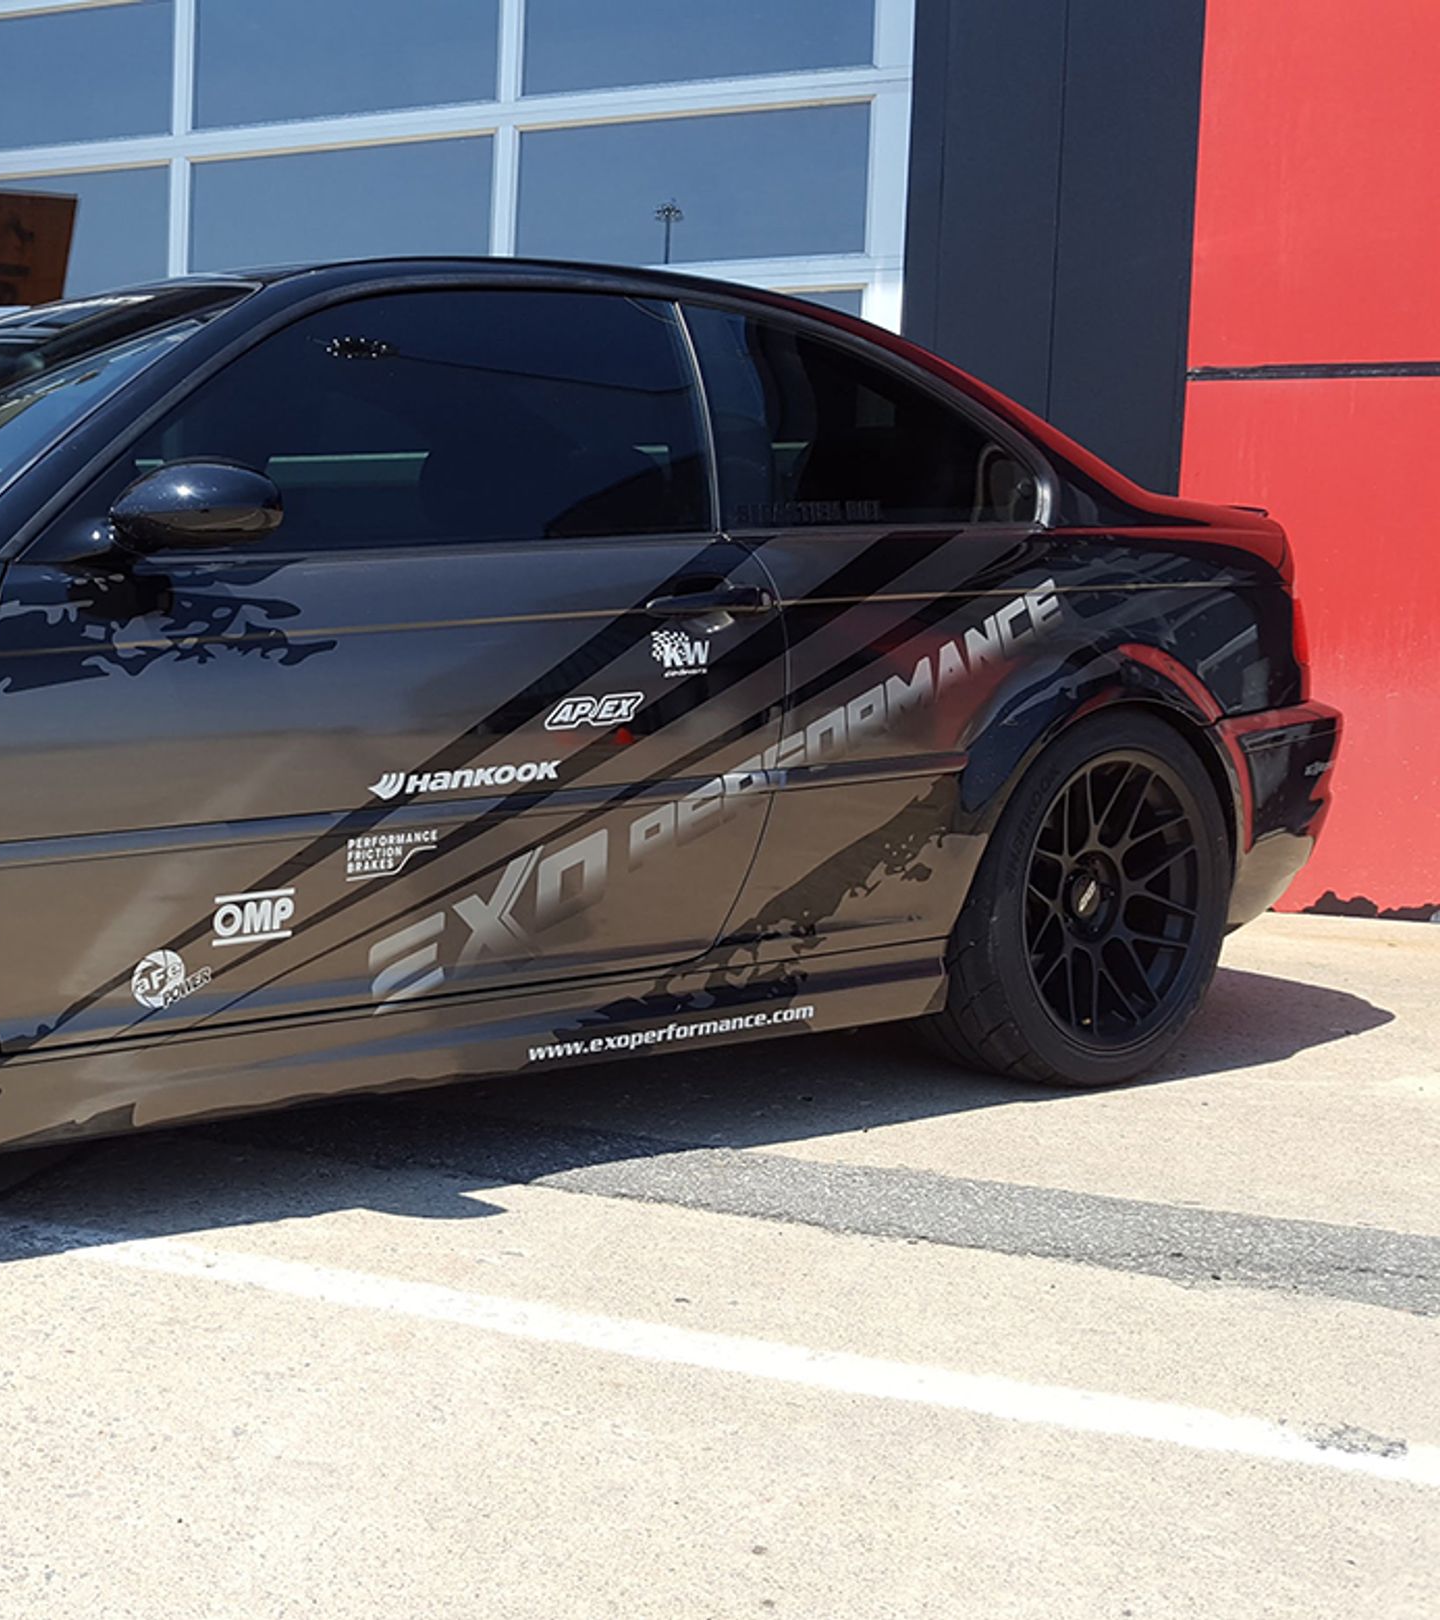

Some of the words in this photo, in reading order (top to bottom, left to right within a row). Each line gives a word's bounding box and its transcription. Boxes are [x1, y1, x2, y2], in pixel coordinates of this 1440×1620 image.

[549, 696, 639, 725] APEX
[346, 829, 439, 849] PERFORMANCE
[346, 846, 403, 862] FRICTION
[346, 858, 395, 874] BRAKES
[213, 897, 295, 938] OMP
[368, 828, 609, 1014] EXO
[527, 1003, 815, 1062] www.exoperformance.com
